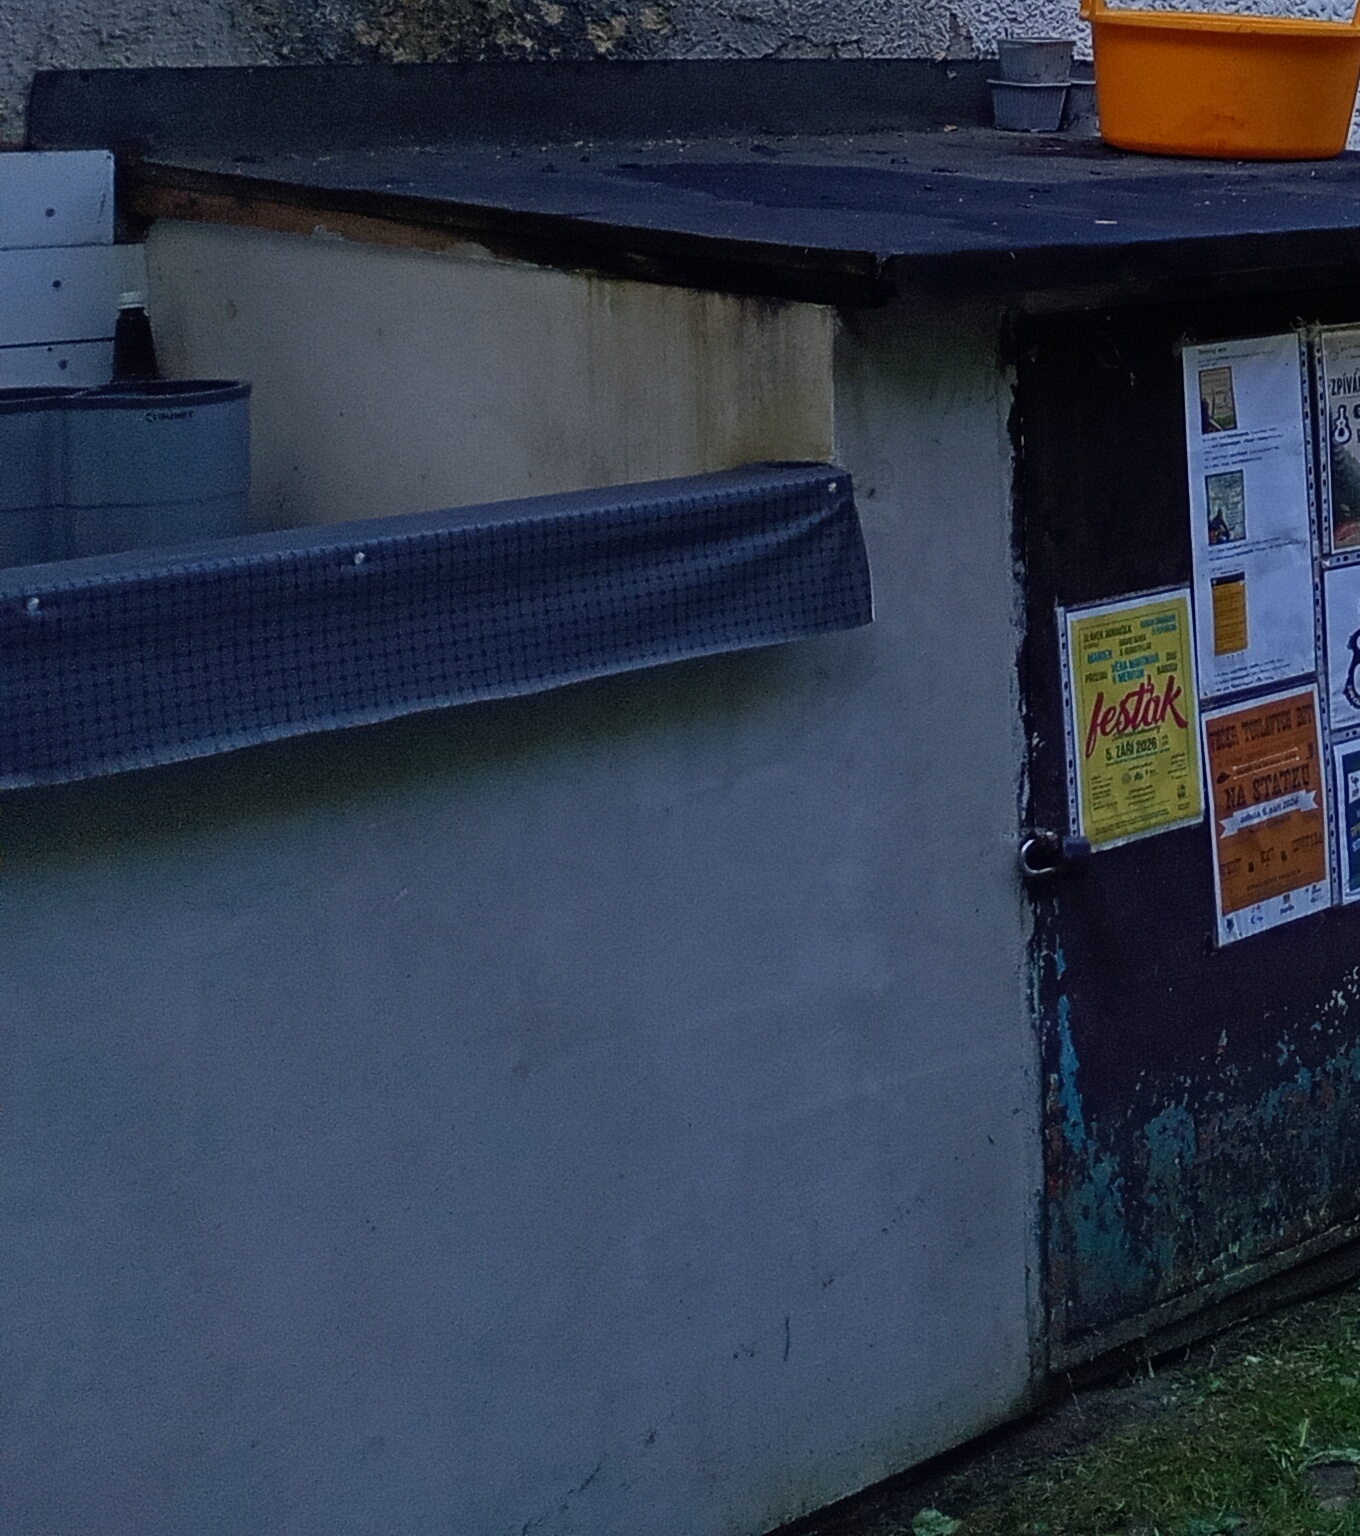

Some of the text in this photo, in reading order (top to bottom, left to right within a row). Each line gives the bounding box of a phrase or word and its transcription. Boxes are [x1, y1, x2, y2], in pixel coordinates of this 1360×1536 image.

[1105, 747, 1113, 761] 5.
[1115, 739, 1134, 758] ZÁŘÍ
[1224, 783, 1248, 810] NA
[1252, 763, 1310, 801] STATKU
